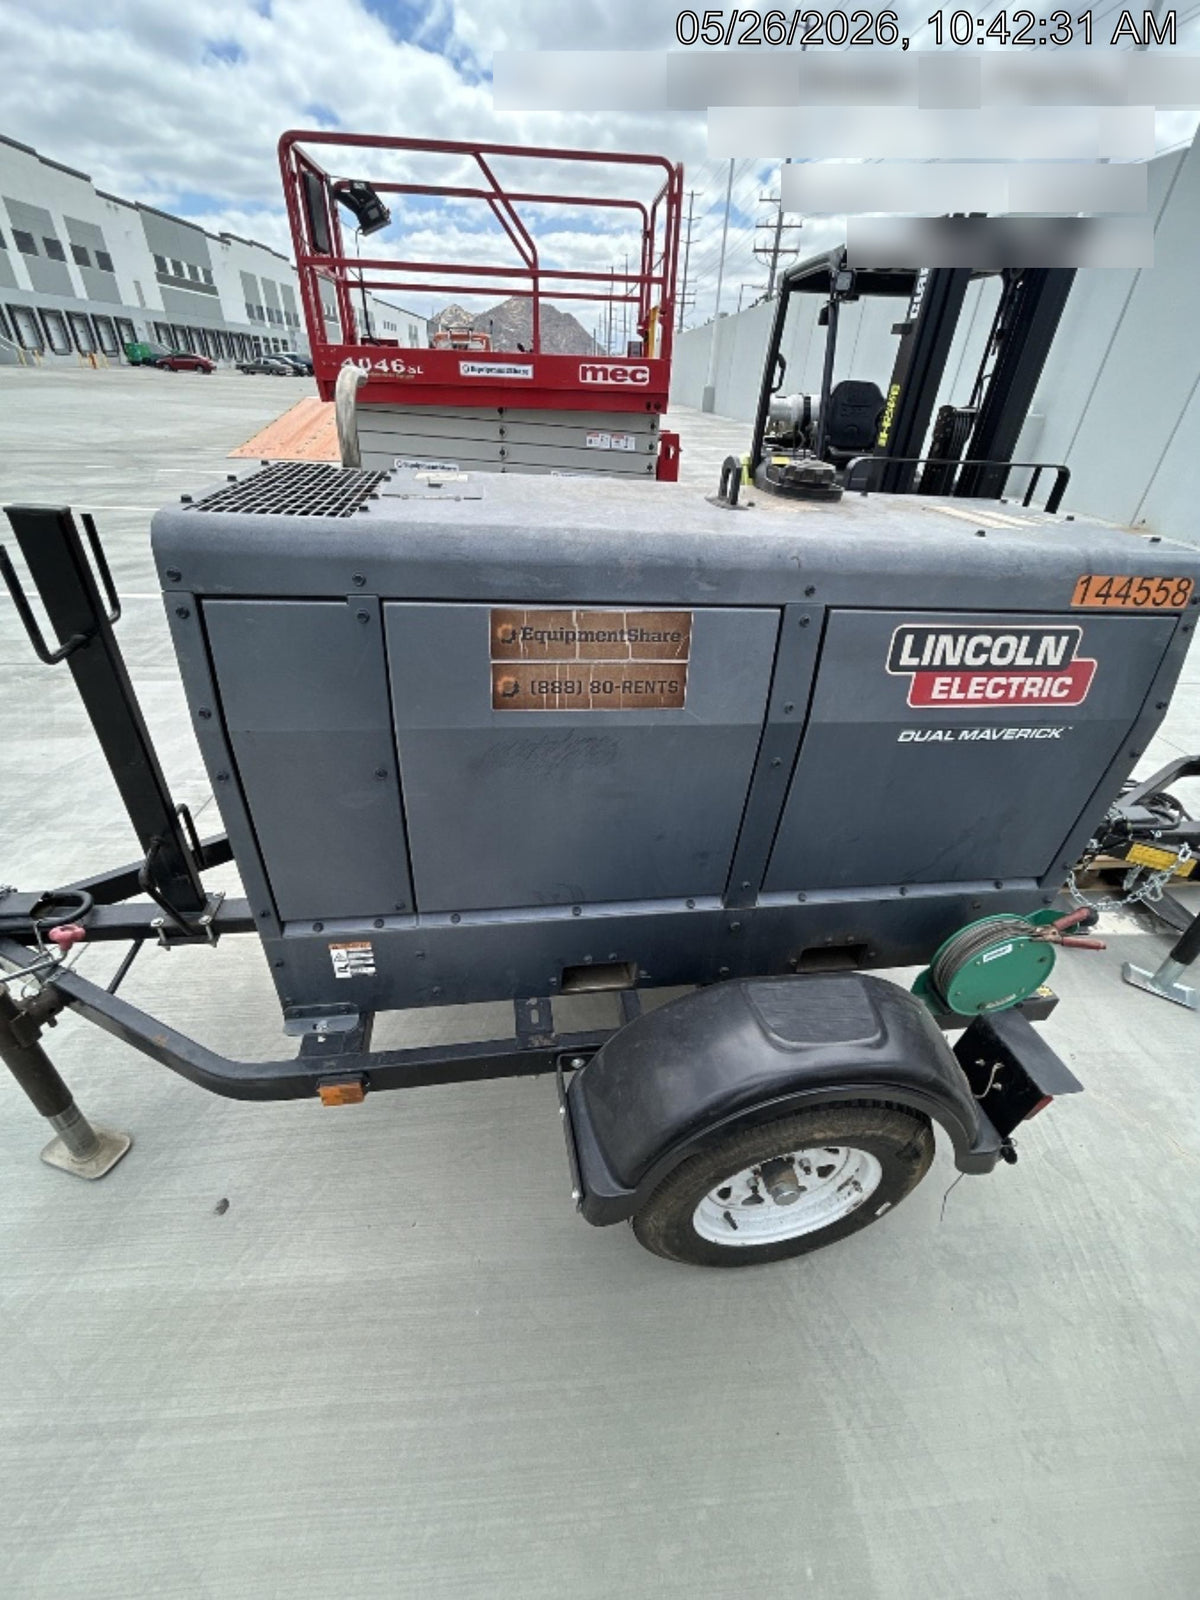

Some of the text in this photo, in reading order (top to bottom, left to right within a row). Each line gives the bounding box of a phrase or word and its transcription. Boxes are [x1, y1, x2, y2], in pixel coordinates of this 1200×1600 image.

[580, 365, 648, 384] mec
[1079, 575, 1192, 607] 144558
[520, 626, 682, 644] EquipmentShare
[899, 633, 1070, 667] LINCOLN
[530, 680, 679, 695] (888) 80-RENTS
[930, 676, 1073, 700] ELECTRIC
[897, 727, 1065, 743] DUAL MAVERICK
